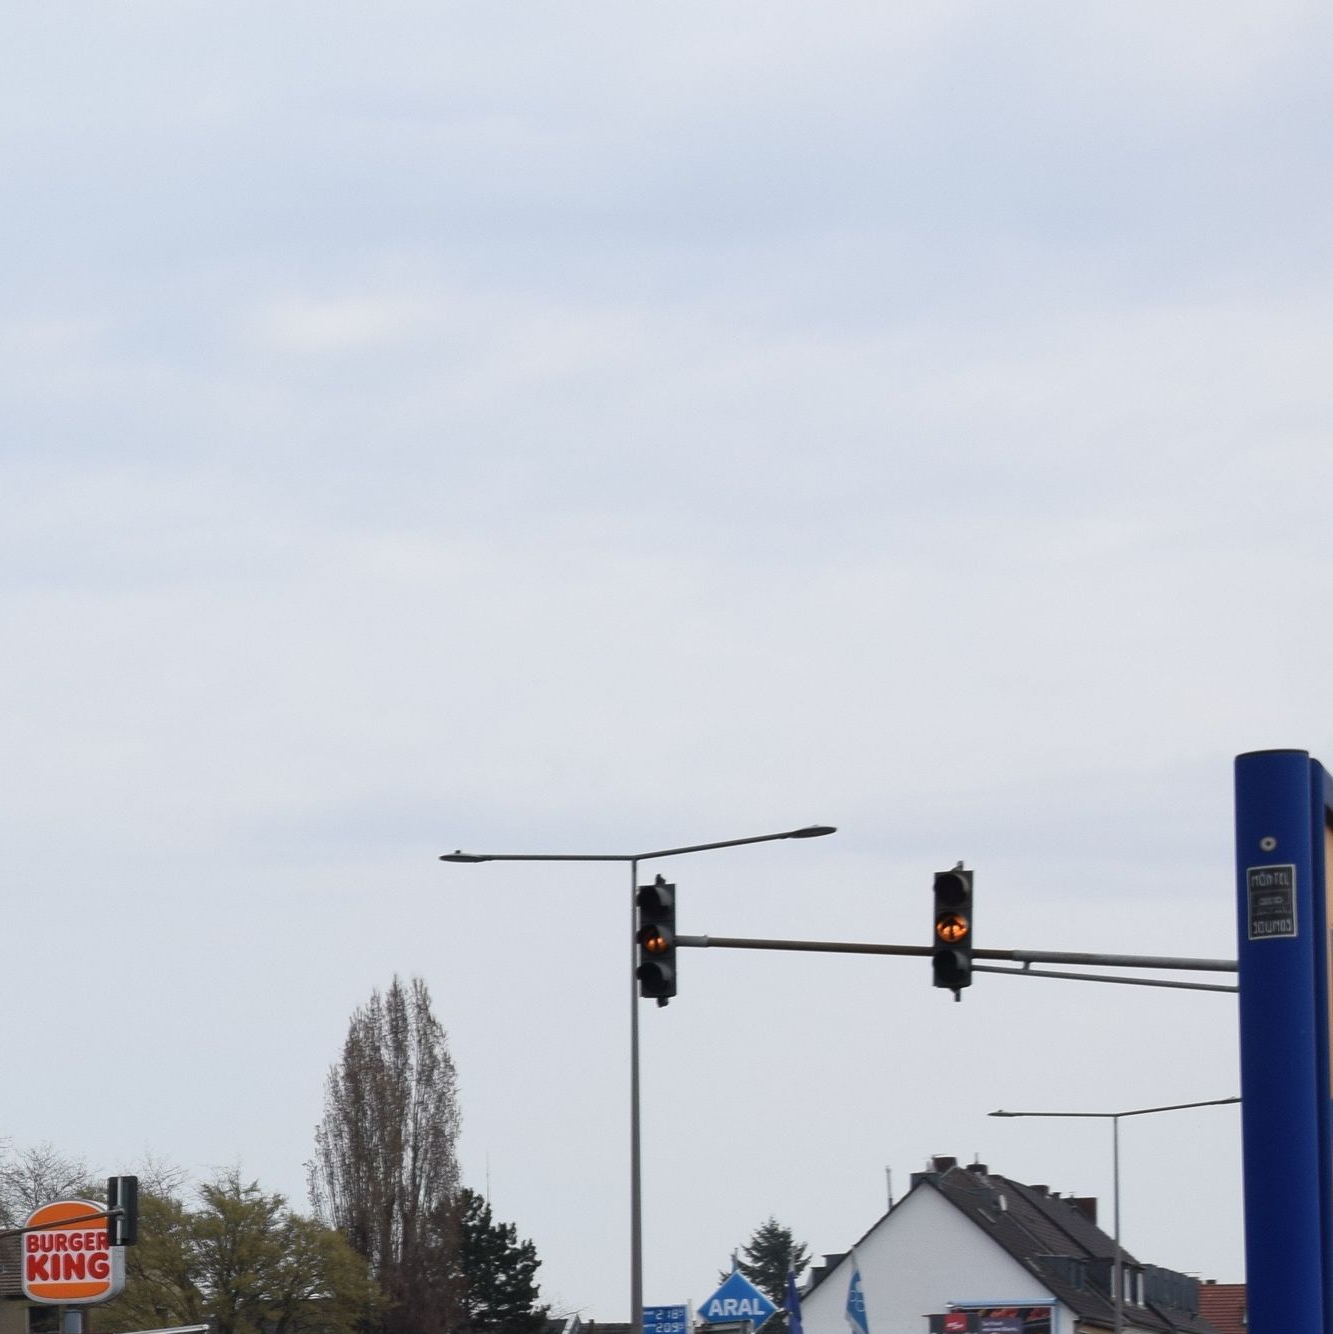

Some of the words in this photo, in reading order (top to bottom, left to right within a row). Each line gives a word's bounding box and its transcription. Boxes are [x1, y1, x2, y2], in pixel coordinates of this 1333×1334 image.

[26, 1232, 110, 1253] BURGER
[26, 1252, 110, 1281] KING
[708, 1298, 766, 1317] ARAL
